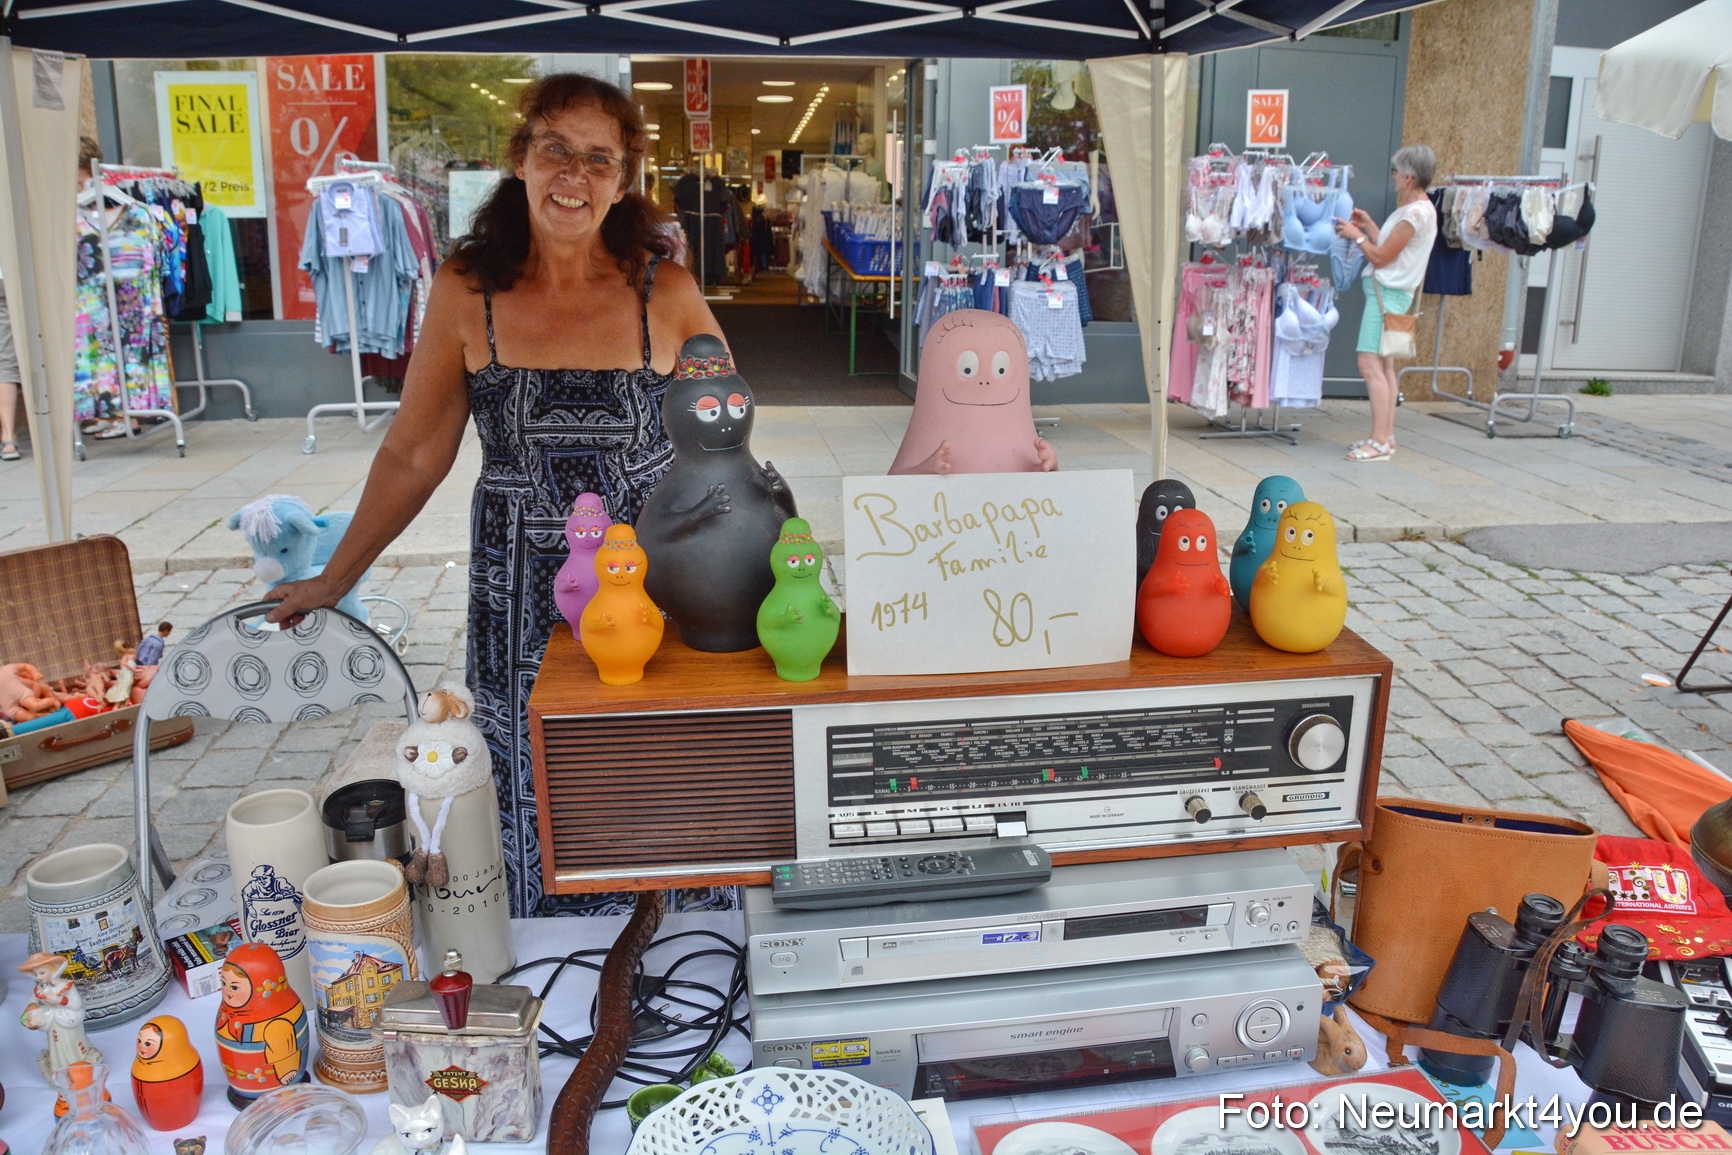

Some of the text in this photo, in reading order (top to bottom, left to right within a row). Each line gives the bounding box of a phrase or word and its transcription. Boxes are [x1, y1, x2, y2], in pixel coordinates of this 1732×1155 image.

[277, 63, 365, 91] SALE
[175, 95, 242, 111] FINAL
[995, 92, 1021, 102] SALE
[1252, 96, 1283, 107] SALE
[177, 113, 244, 134] SALE
[997, 108, 1019, 134] %
[1255, 113, 1279, 138] %
[203, 181, 250, 193] /2 Preis
[853, 491, 1063, 561] Barbapapa
[928, 530, 1048, 581] Familie
[871, 592, 928, 631] 1974
[1179, 787, 1210, 795] LAUTSTÄRKE
[1232, 783, 1266, 791] KLANGWAAGE
[1288, 793, 1324, 801] GRUNDIG
[1615, 901, 1693, 911] TERNATIONAL AIRWAYS
[250, 911, 298, 938] Glossner
[275, 928, 300, 939] Bier
[760, 938, 806, 949] SONY
[1009, 1026, 1083, 1040] smart engine
[763, 1042, 810, 1053] SONY
[433, 1077, 477, 1089] GESKA
[1600, 1133, 1732, 1151] BUSCH
